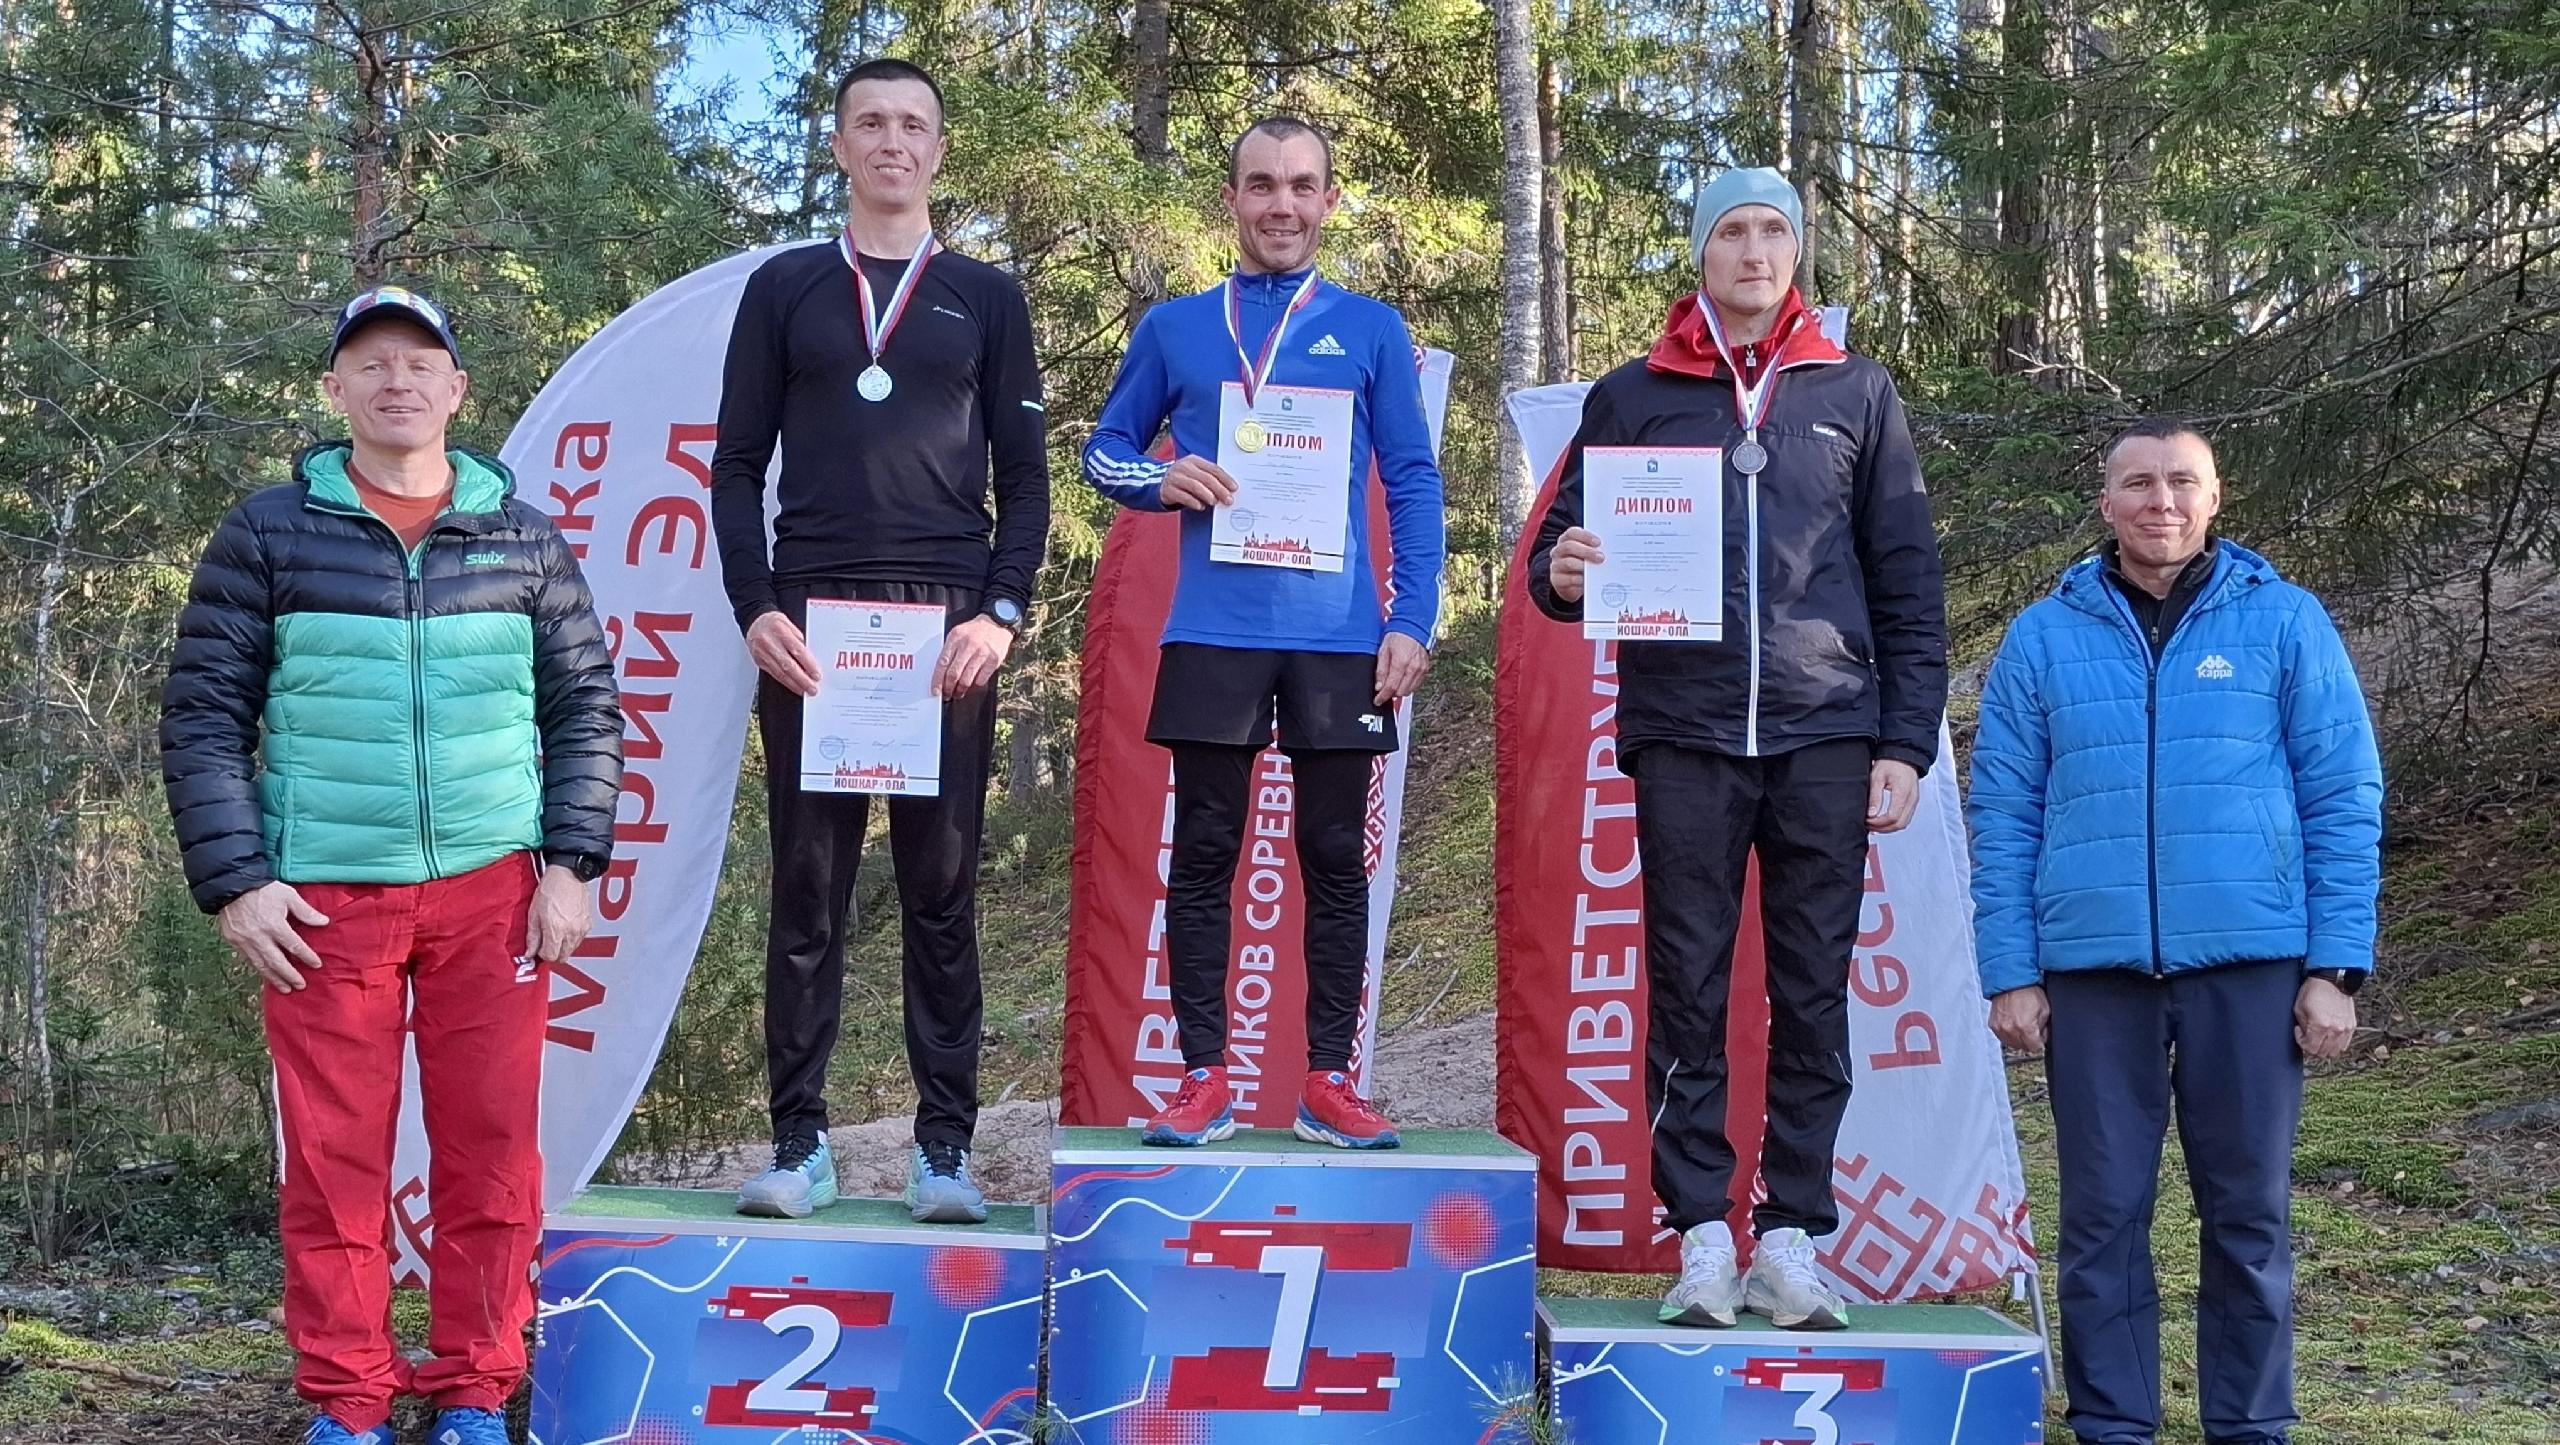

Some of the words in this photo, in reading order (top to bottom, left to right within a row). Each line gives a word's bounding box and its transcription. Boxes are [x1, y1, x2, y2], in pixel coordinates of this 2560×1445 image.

[1267, 432, 1322, 451] ПЛОМ
[1615, 496, 1693, 515] ДИПЛОМ
[835, 651, 914, 670] ДИПЛОМ
[1245, 752, 1295, 931] СОРЕВН
[1227, 944, 1276, 1128] НИКОВ
[744, 1303, 841, 1412] 2
[1258, 1245, 1324, 1387] 1
[1771, 1373, 1844, 1445] 3
